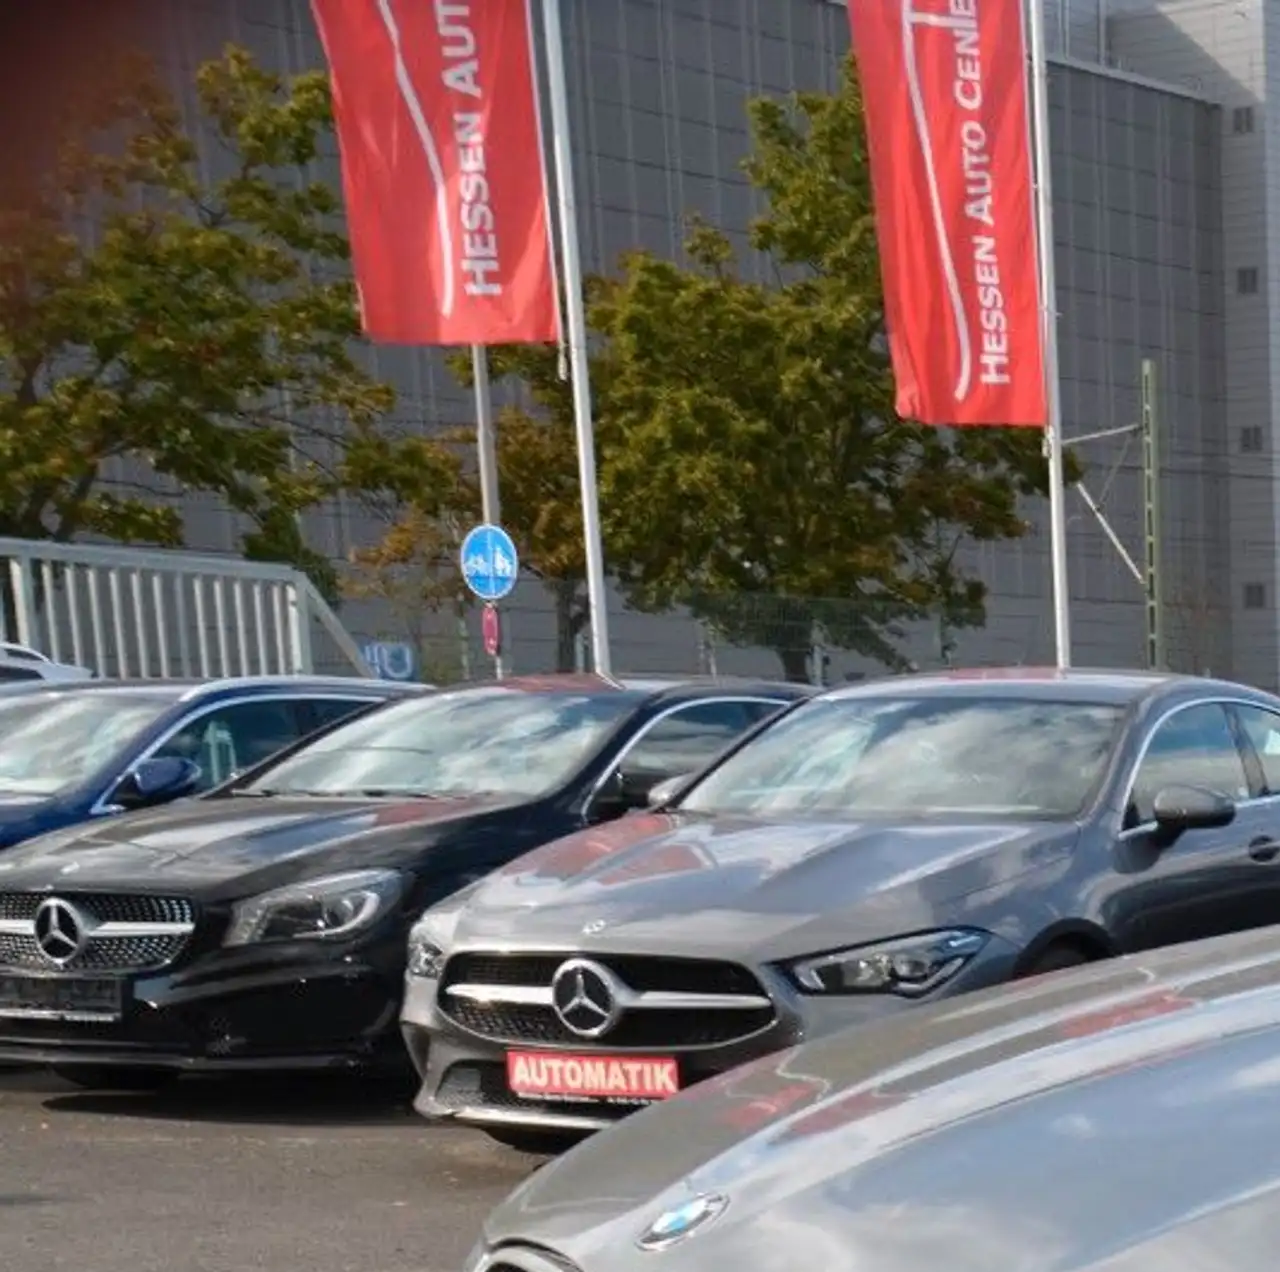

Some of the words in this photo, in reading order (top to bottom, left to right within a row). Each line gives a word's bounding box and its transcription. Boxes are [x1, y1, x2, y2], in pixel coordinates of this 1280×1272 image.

[452, 112, 502, 295] HESSEN
[960, 122, 995, 224] AUTO
[972, 237, 1010, 385] HESSEN
[513, 1055, 678, 1094] AUTOMATIK
